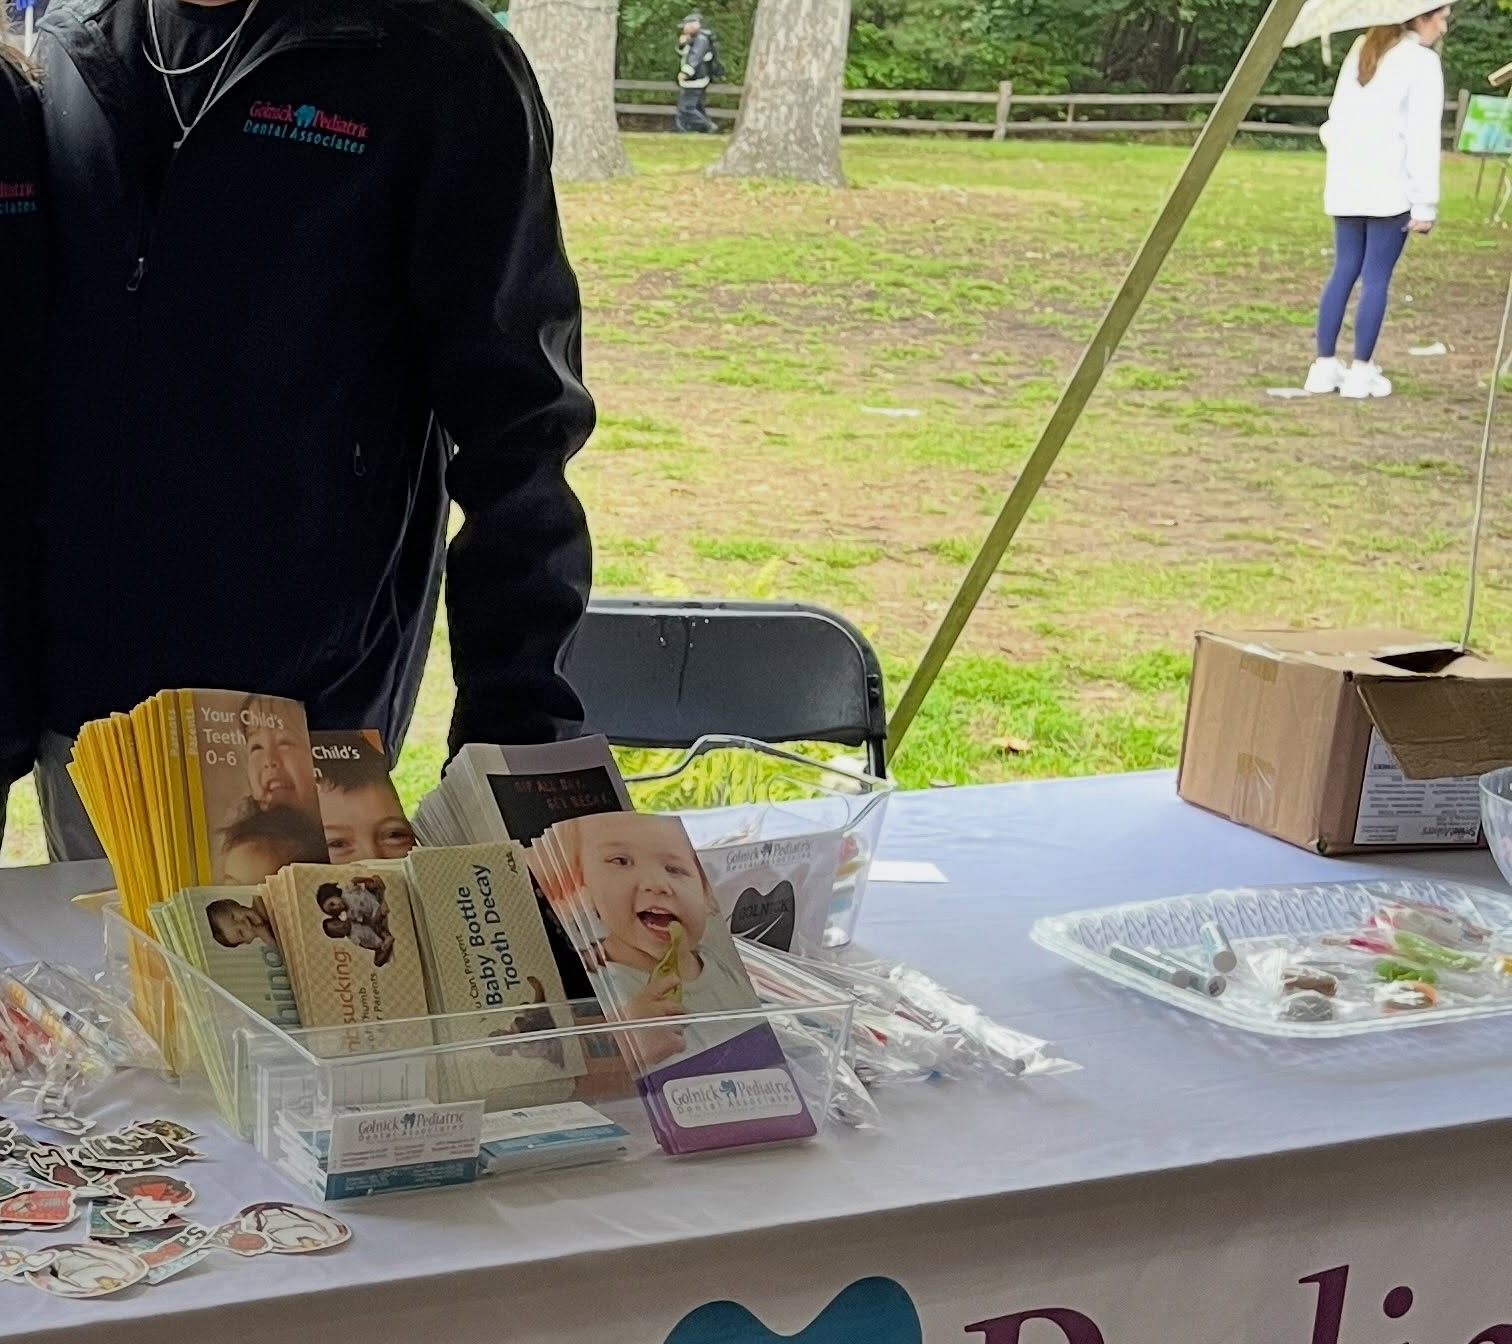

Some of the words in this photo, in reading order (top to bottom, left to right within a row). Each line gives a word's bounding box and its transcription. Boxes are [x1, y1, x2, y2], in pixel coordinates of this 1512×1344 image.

[243, 119, 288, 138] Dental
[289, 127, 366, 154] Associates
[201, 707, 236, 723] Your
[240, 709, 284, 730] Child's
[203, 728, 247, 745] Teeth
[206, 749, 237, 766] 0-6
[311, 745, 361, 760] Child's
[472, 864, 501, 924] Decay
[457, 886, 485, 947] Bottle
[491, 931, 521, 990] Tooth
[370, 972, 382, 1013] Parents
[469, 978, 480, 999] Can
[478, 954, 503, 1006] Baby
[671, 1083, 721, 1106] Golnick
[736, 1079, 792, 1098] Pediatric
[358, 1118, 399, 1135] Golnick
[416, 1112, 464, 1127] Pediatric
